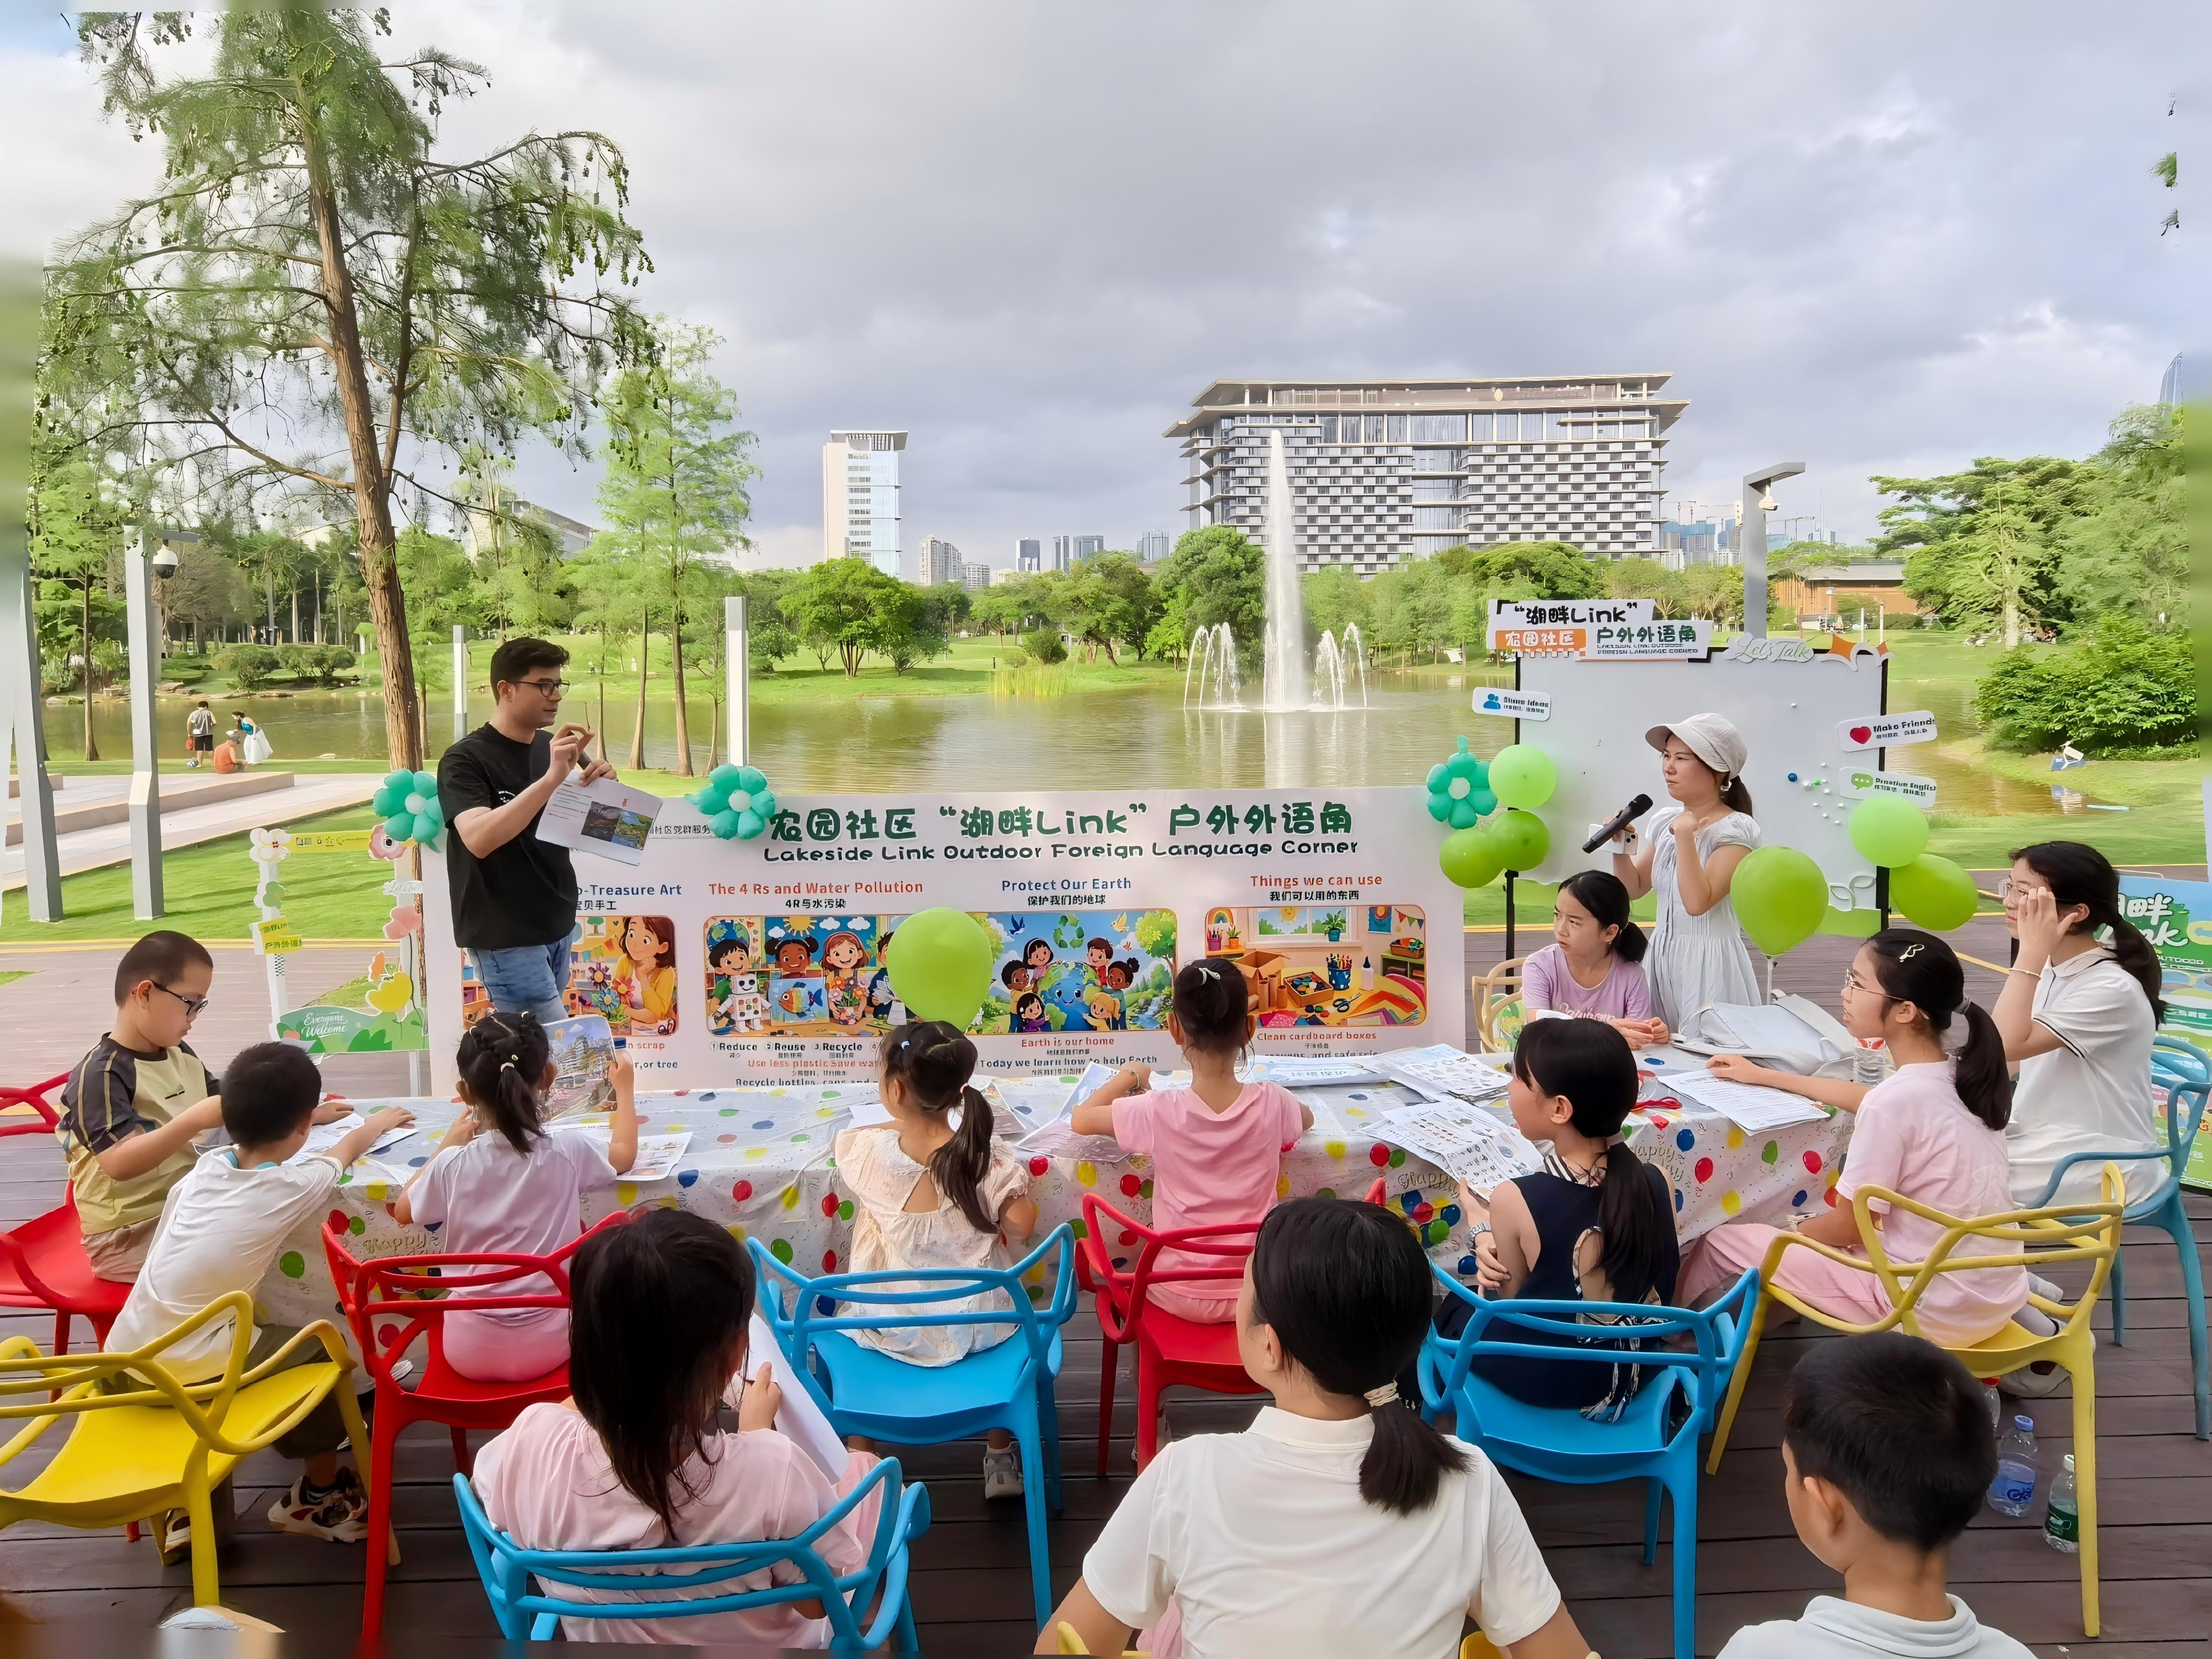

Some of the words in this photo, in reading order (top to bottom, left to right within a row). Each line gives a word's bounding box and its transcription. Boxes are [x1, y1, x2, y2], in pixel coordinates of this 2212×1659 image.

[1597, 625, 1696, 643] 户外外语角
[1776, 641, 1809, 659] Talk
[1873, 724, 1899, 732] Make
[1170, 801, 1351, 836] 户外外语角
[764, 846, 873, 862] Lakeside
[882, 846, 935, 860] Link
[944, 845, 1042, 860] Outdoor
[1051, 843, 1143, 859] Foreign
[1152, 842, 1272, 858] Language
[1282, 840, 1358, 854] Corner
[709, 883, 735, 895] The
[739, 884, 748, 894] 4
[753, 884, 769, 894] Rs
[774, 882, 801, 894] and
[806, 882, 849, 894] Water
[855, 881, 923, 893] Pollution
[1002, 880, 1056, 891] Protect
[1061, 879, 1087, 890] Our
[1092, 877, 1131, 889] Earth
[1250, 875, 1298, 889] Things
[1304, 876, 1323, 886] we
[1328, 876, 1353, 885] can
[1358, 875, 1382, 885] use
[660, 885, 682, 895] Art
[1270, 890, 1359, 901] 我们可以用的东西
[1028, 894, 1105, 906] 保护我们的地球
[304, 1011, 348, 1026] Everyone
[301, 1025, 347, 1037] Welcome
[1290, 1031, 1342, 1040] cardboard
[637, 1043, 665, 1051] scrap
[1022, 1037, 1050, 1047] Earth
[1054, 1037, 1062, 1047] is
[1086, 1037, 1115, 1046] home
[793, 1060, 828, 1068] plastic
[980, 1059, 1011, 1069] Today
[1104, 1056, 1125, 1066] help
[736, 1078, 775, 1087] Recycle
